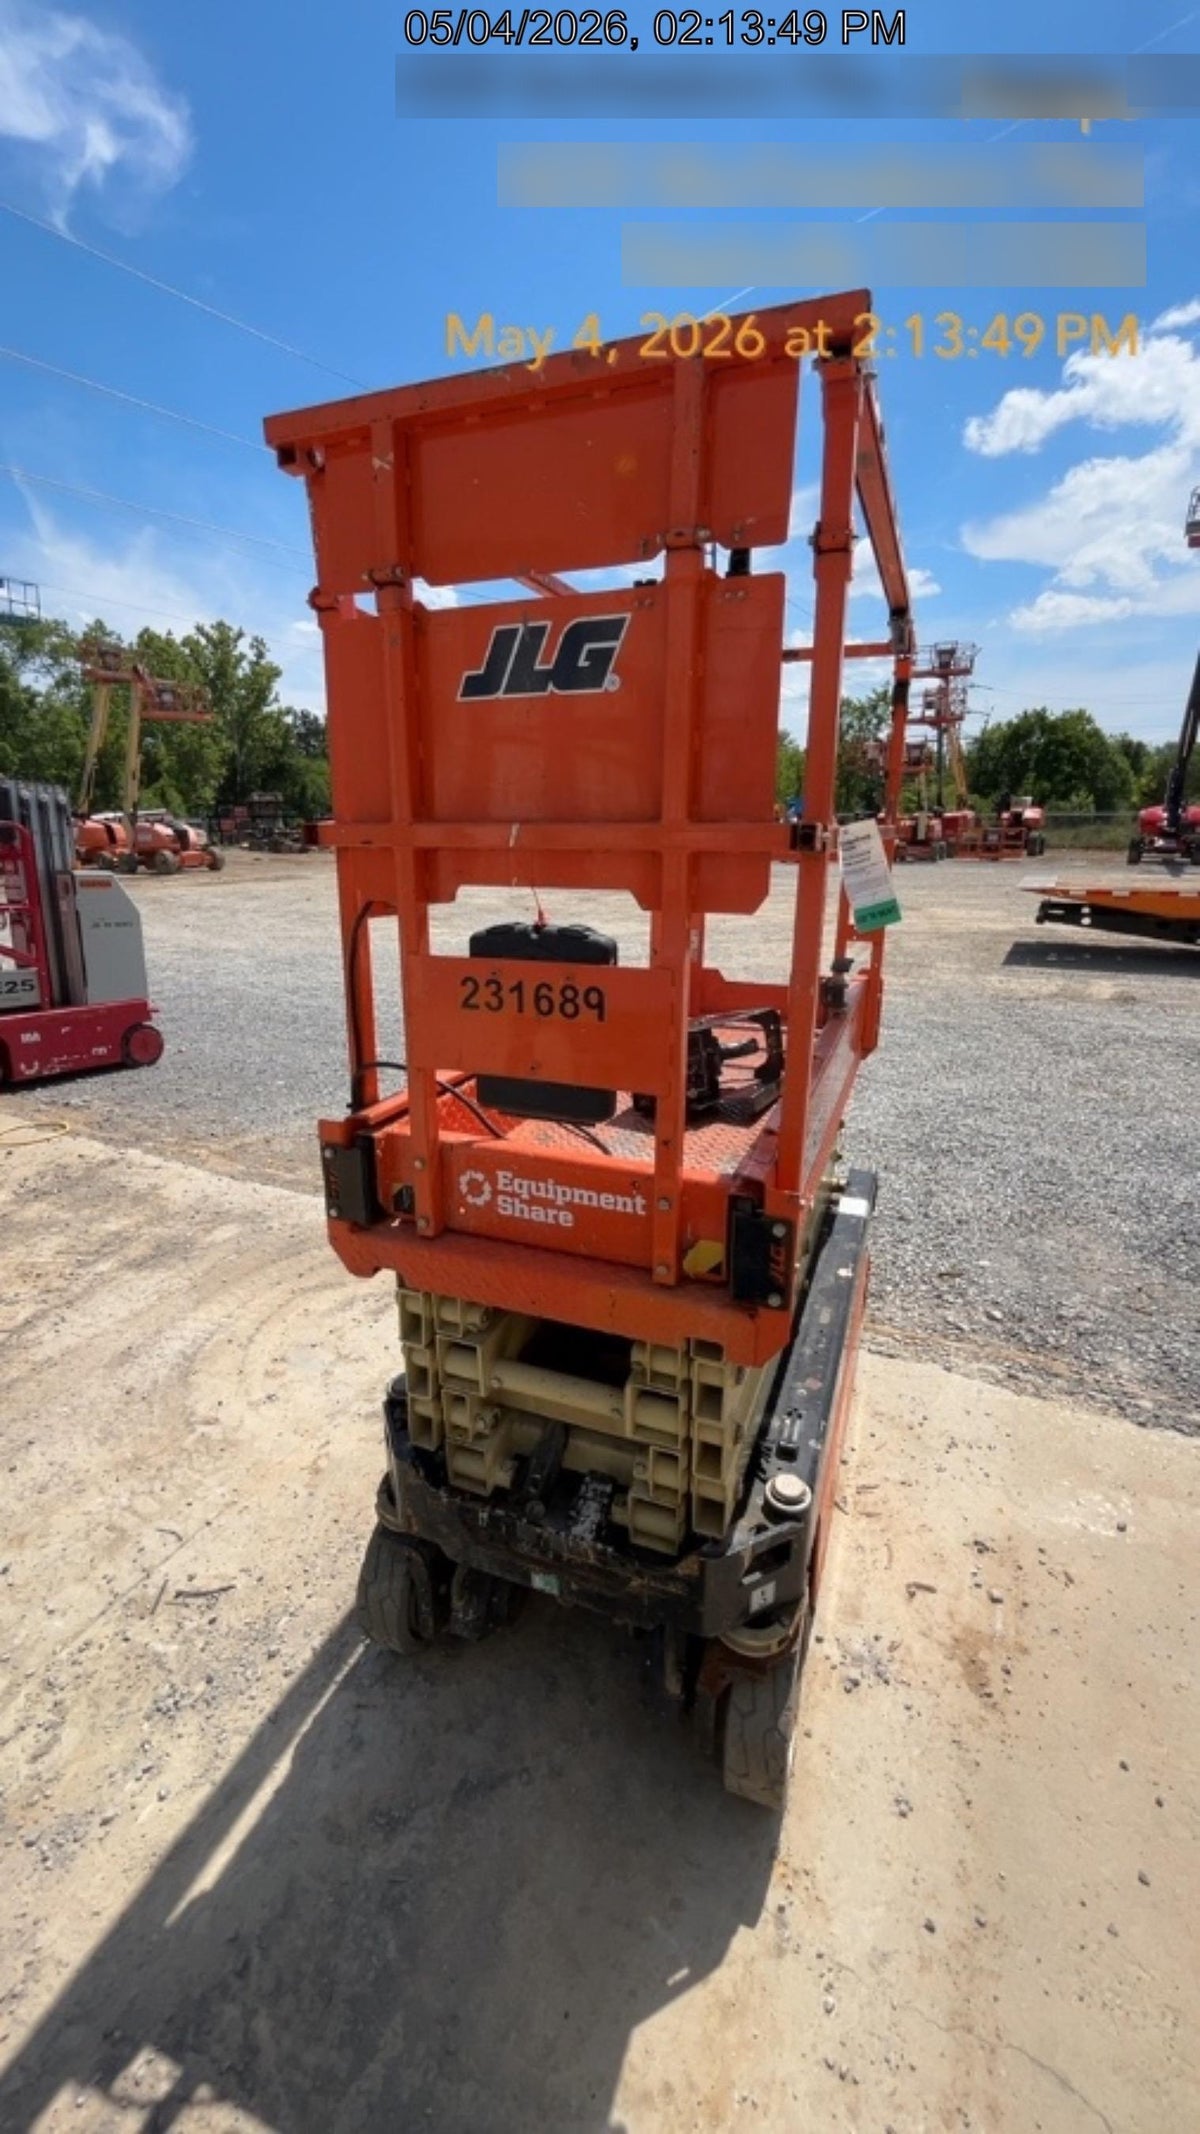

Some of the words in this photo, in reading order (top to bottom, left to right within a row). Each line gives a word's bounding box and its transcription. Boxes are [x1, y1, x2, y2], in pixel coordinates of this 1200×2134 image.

[457, 612, 632, 702] JLG
[460, 976, 606, 1023] 231689
[496, 1170, 647, 1216] Equipment
[497, 1195, 574, 1227] Share
